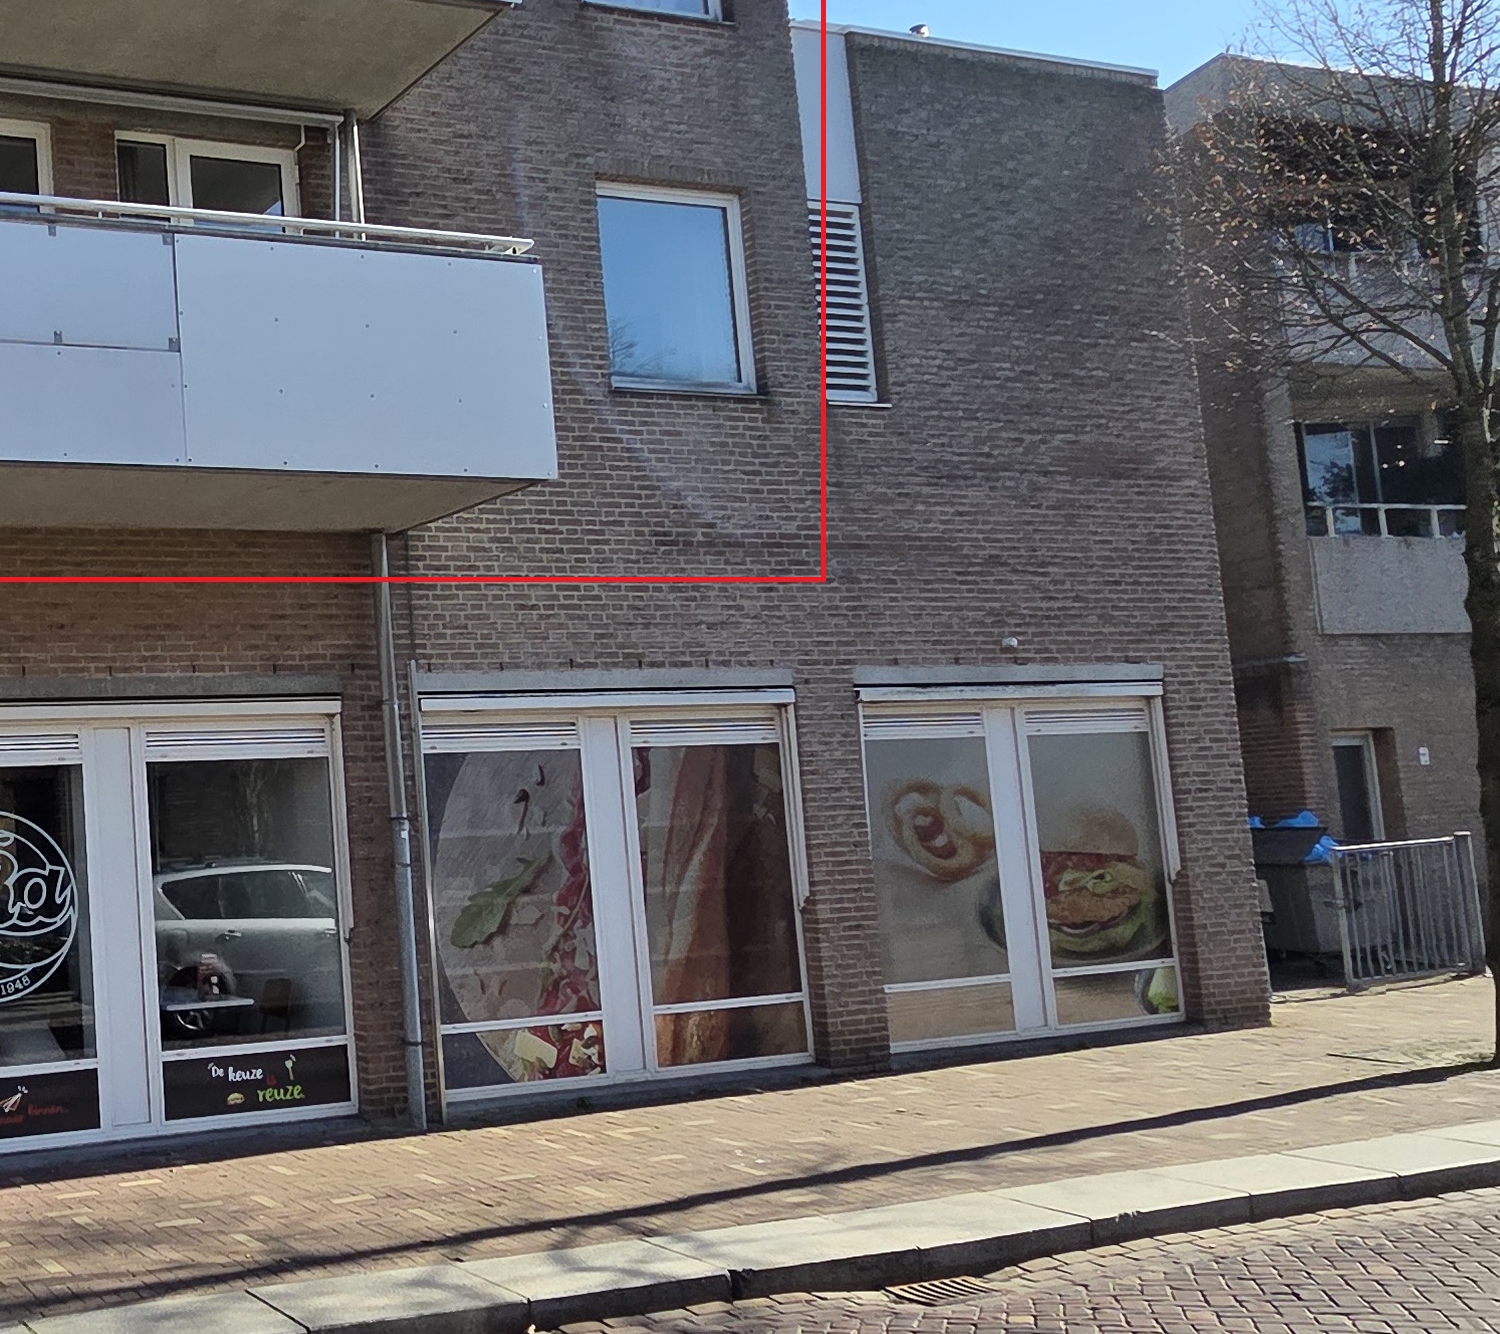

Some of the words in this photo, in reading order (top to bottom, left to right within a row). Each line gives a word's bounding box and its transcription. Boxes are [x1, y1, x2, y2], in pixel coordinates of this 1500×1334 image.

[0, 974, 31, 996] 1948
[211, 1065, 225, 1078] De
[228, 1066, 264, 1082] keuze
